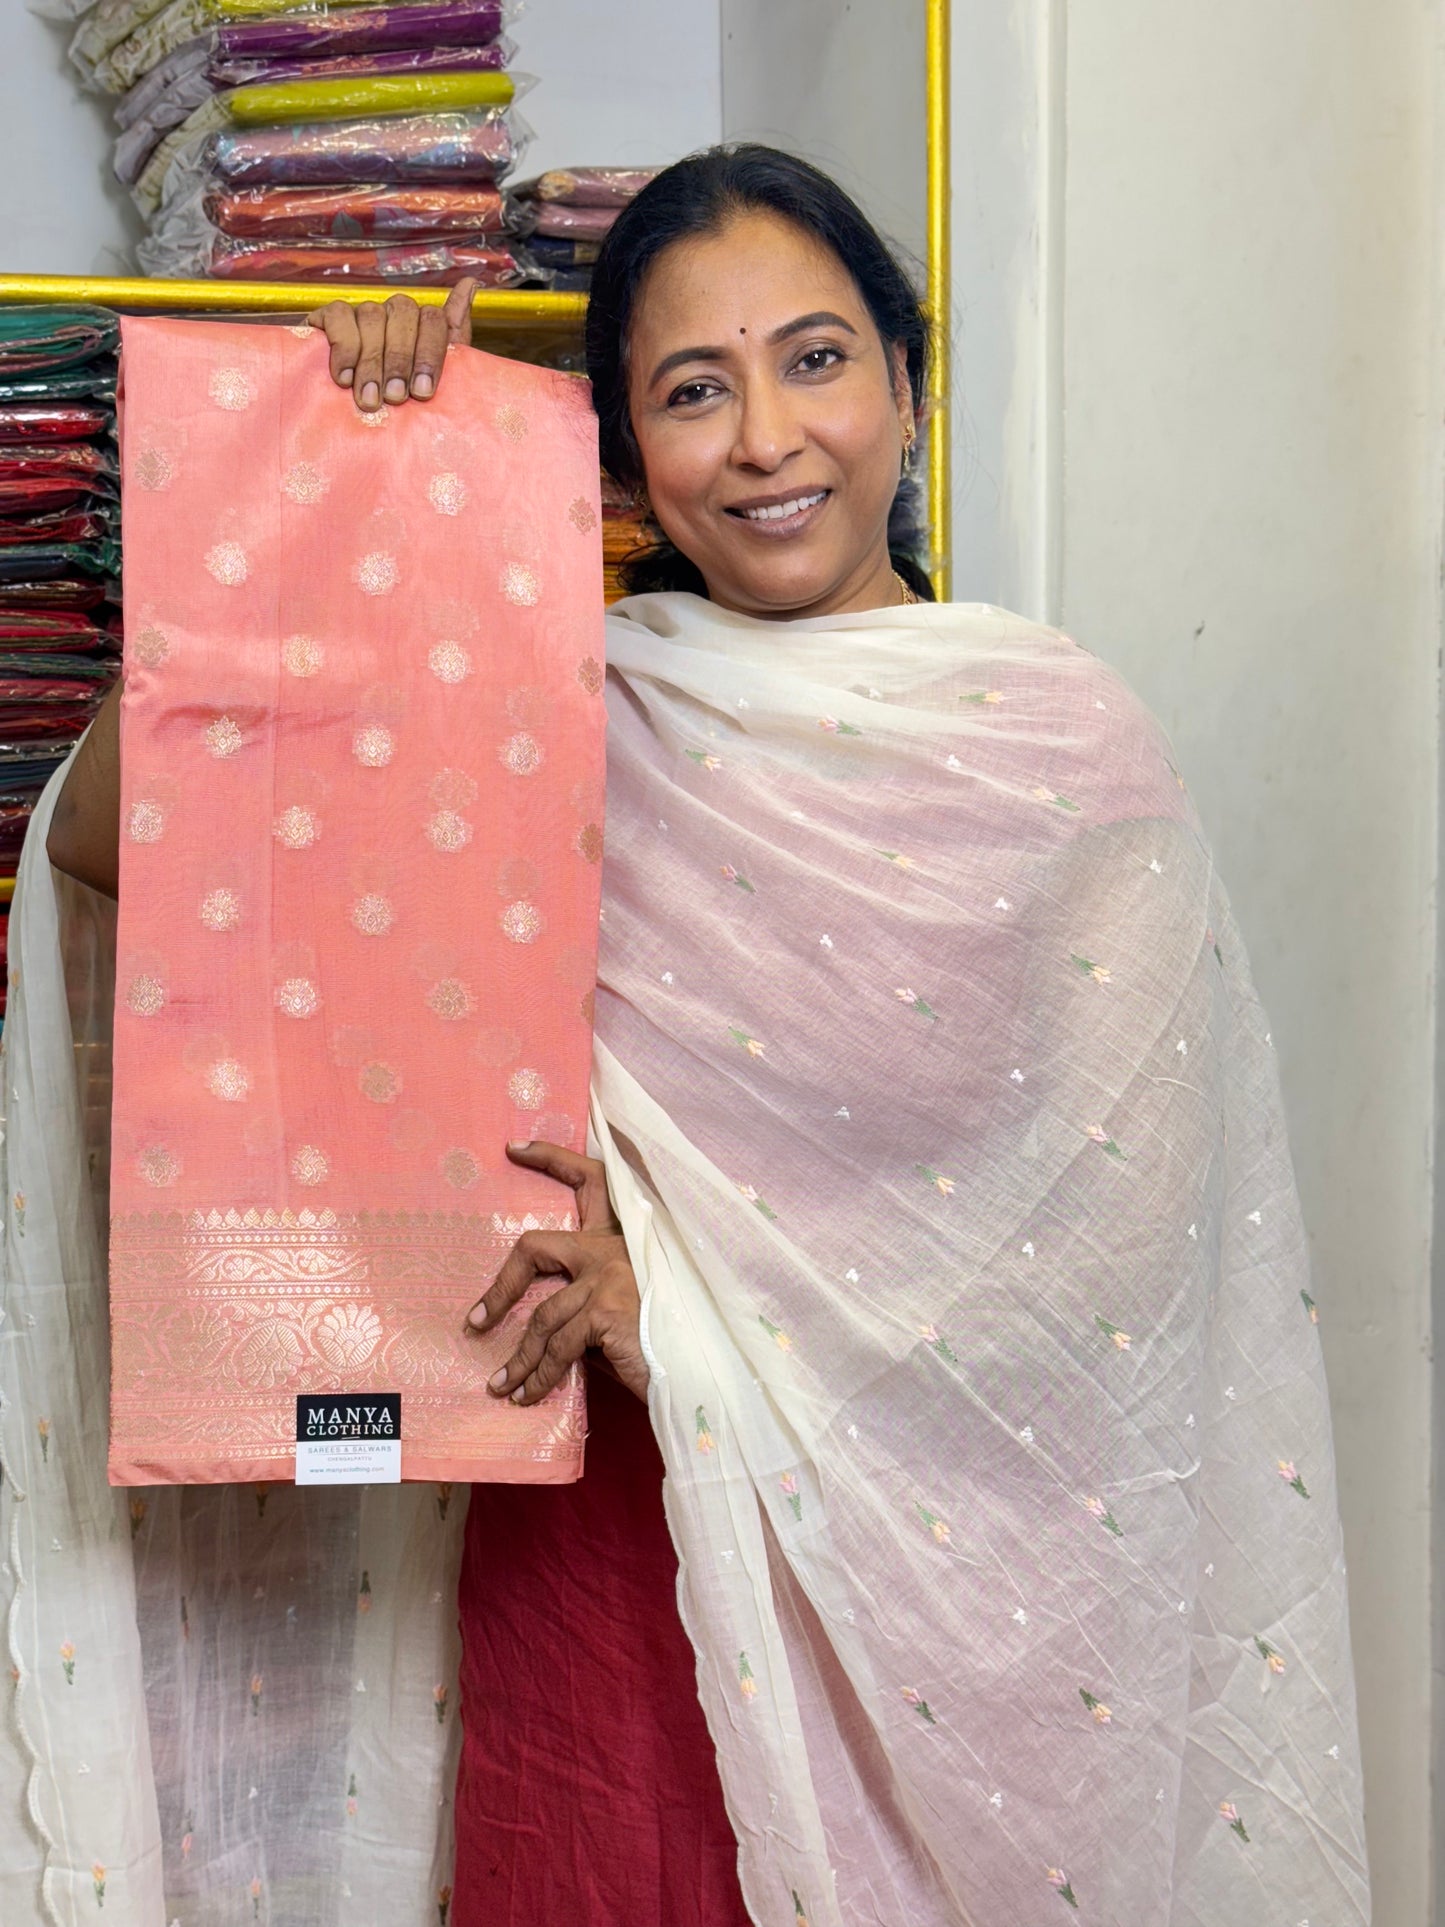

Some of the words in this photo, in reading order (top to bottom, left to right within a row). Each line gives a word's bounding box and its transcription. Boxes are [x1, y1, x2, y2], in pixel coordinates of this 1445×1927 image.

[307, 1407, 393, 1424] MANYA
[306, 1424, 394, 1436] CLOTHING
[308, 1446, 340, 1454] SAREES
[352, 1445, 392, 1453] SALWARS
